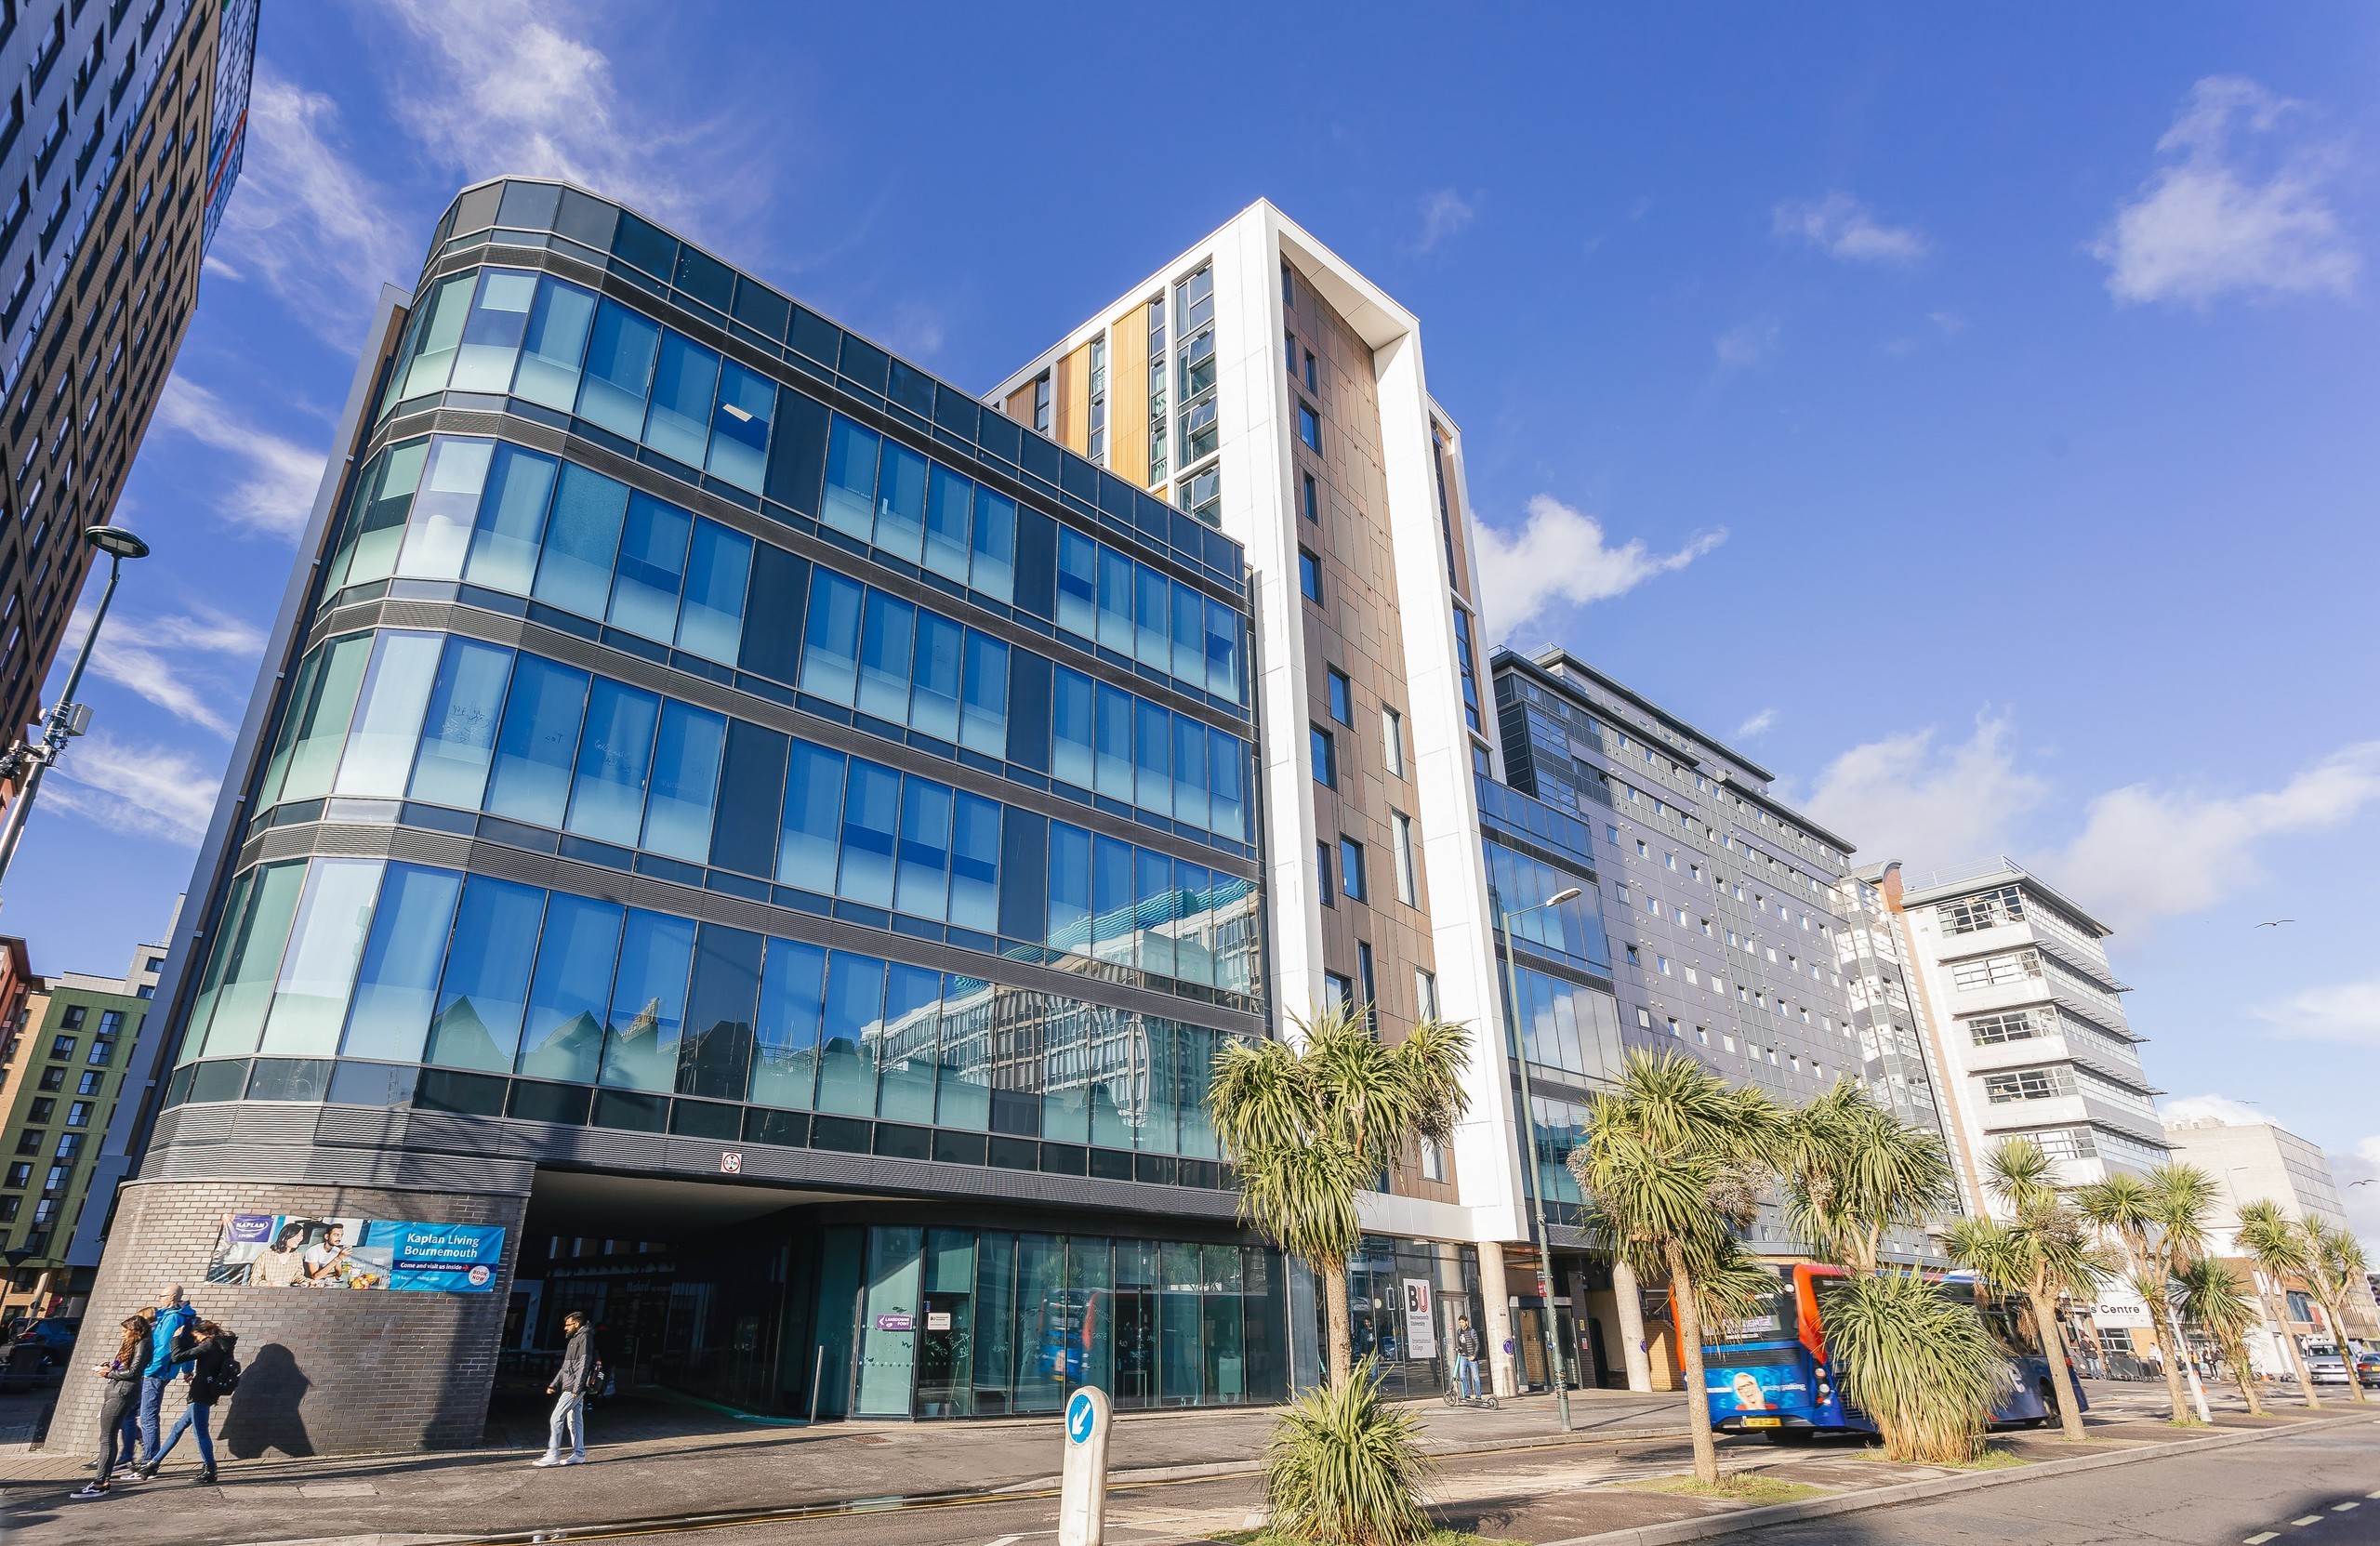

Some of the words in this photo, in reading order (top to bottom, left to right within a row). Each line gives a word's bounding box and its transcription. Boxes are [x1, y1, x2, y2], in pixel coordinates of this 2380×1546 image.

[407, 1233, 444, 1245] Kaplan
[448, 1235, 480, 1247] Living
[404, 1246, 478, 1258] Bournemouth
[1408, 1285, 1428, 1313] BU
[2100, 1304, 2140, 1314] Centre
